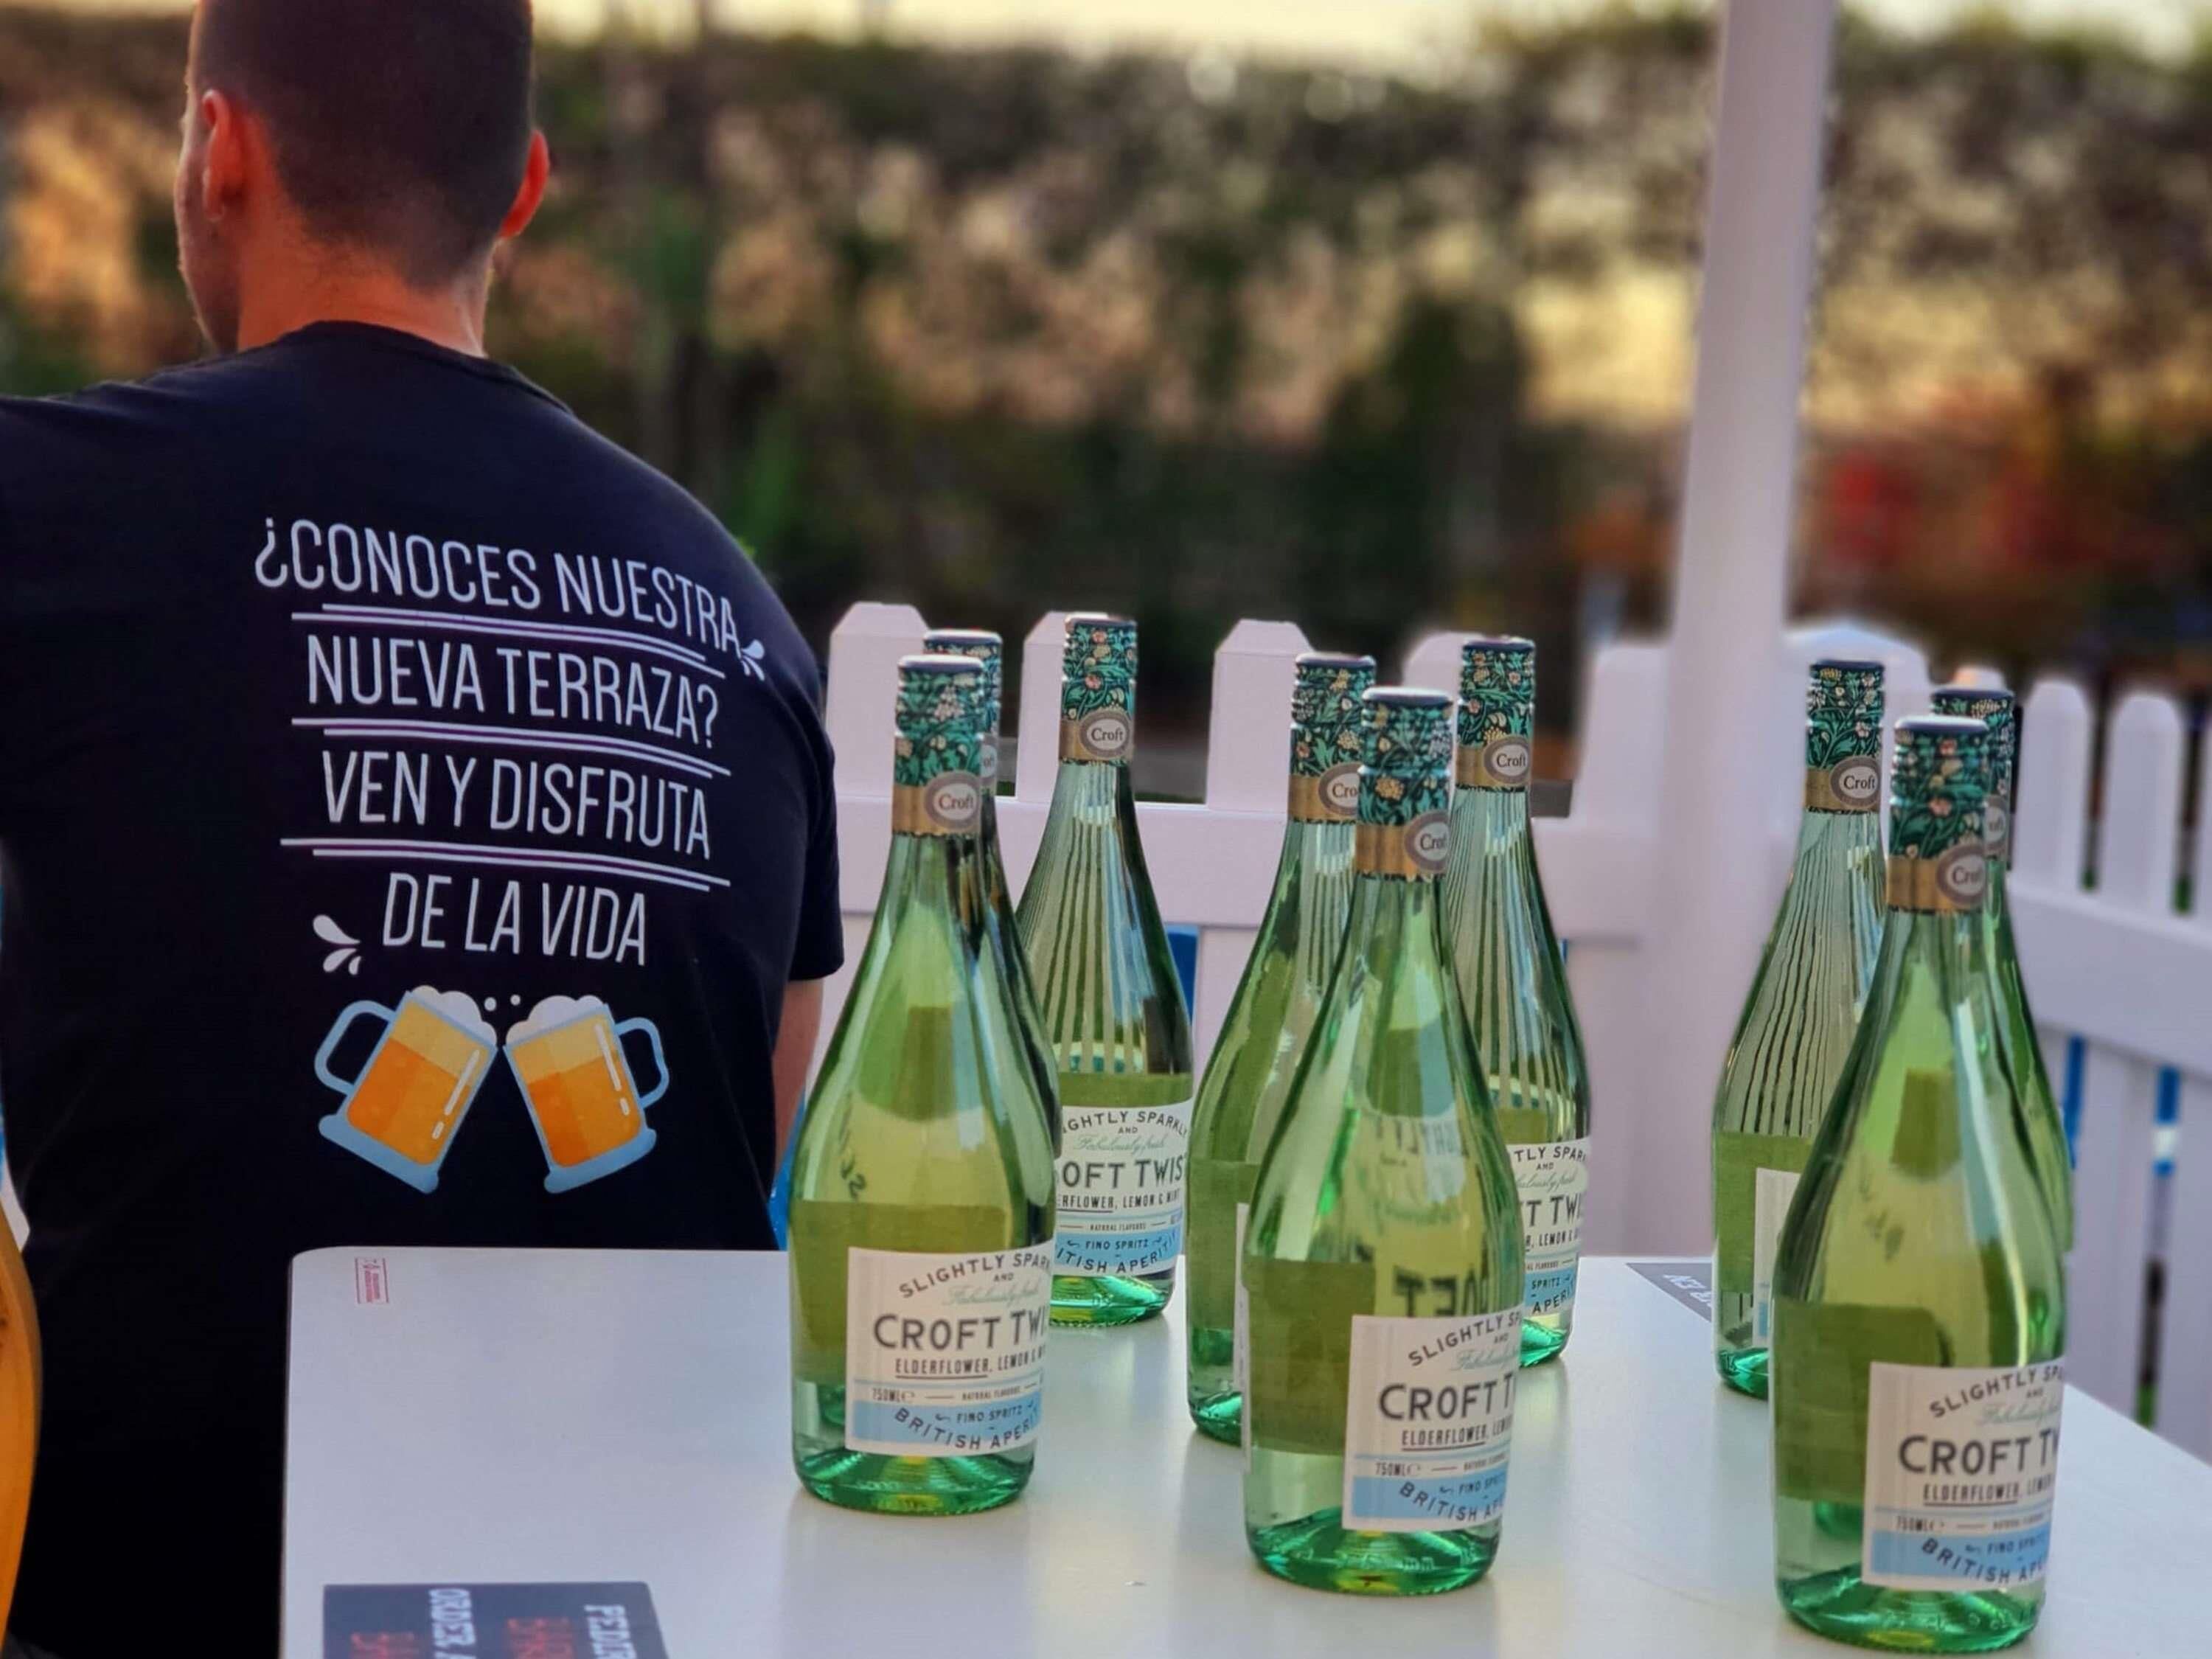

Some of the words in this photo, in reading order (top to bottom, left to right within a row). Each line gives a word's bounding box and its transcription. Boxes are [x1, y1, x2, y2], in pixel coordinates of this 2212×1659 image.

[254, 518, 540, 610] ¿CONOCES
[554, 552, 741, 659] NUESTRA
[307, 634, 484, 713] NUEVA
[496, 647, 720, 749] TERRAZA?
[1091, 726, 1124, 742] Croft
[1496, 751, 1528, 768] Croft
[1843, 773, 1877, 791] Croft
[322, 750, 429, 826] VEN
[445, 754, 477, 827] Y
[490, 758, 711, 860] DISFRUTA
[938, 792, 975, 811] Croft
[382, 872, 452, 949] DE
[465, 878, 521, 955] LA
[542, 883, 646, 967] VIDA
[1117, 1127, 1138, 1135] AND
[1513, 1147, 1546, 1163] TLY
[1535, 1161, 1555, 1171] AND
[1062, 1161, 1126, 1189] OFT
[1122, 1193, 1155, 1209] LEMON
[1085, 1239, 1110, 1251] FINO
[1114, 1238, 1150, 1251] SPRITZ
[1538, 1230, 1567, 1247] LEMON
[899, 1254, 1006, 1299] SLIGHTLY
[992, 1271, 1015, 1282] AND
[1531, 1276, 1561, 1290] SPRITZ
[873, 1312, 1001, 1352] CROFT
[1408, 1314, 1503, 1366] SLIGHTLY
[1378, 1380, 1498, 1422] CROFT
[1929, 1367, 2037, 1419] SLIGHTLY
[893, 1406, 981, 1450] BRITISH
[956, 1412, 985, 1425] FINO
[989, 1405, 1023, 1422] SPRITZ
[1898, 1434, 2032, 1477] CROFT
[1398, 1480, 1478, 1523] BRITISH
[1921, 1537, 2011, 1585] BRITISH
